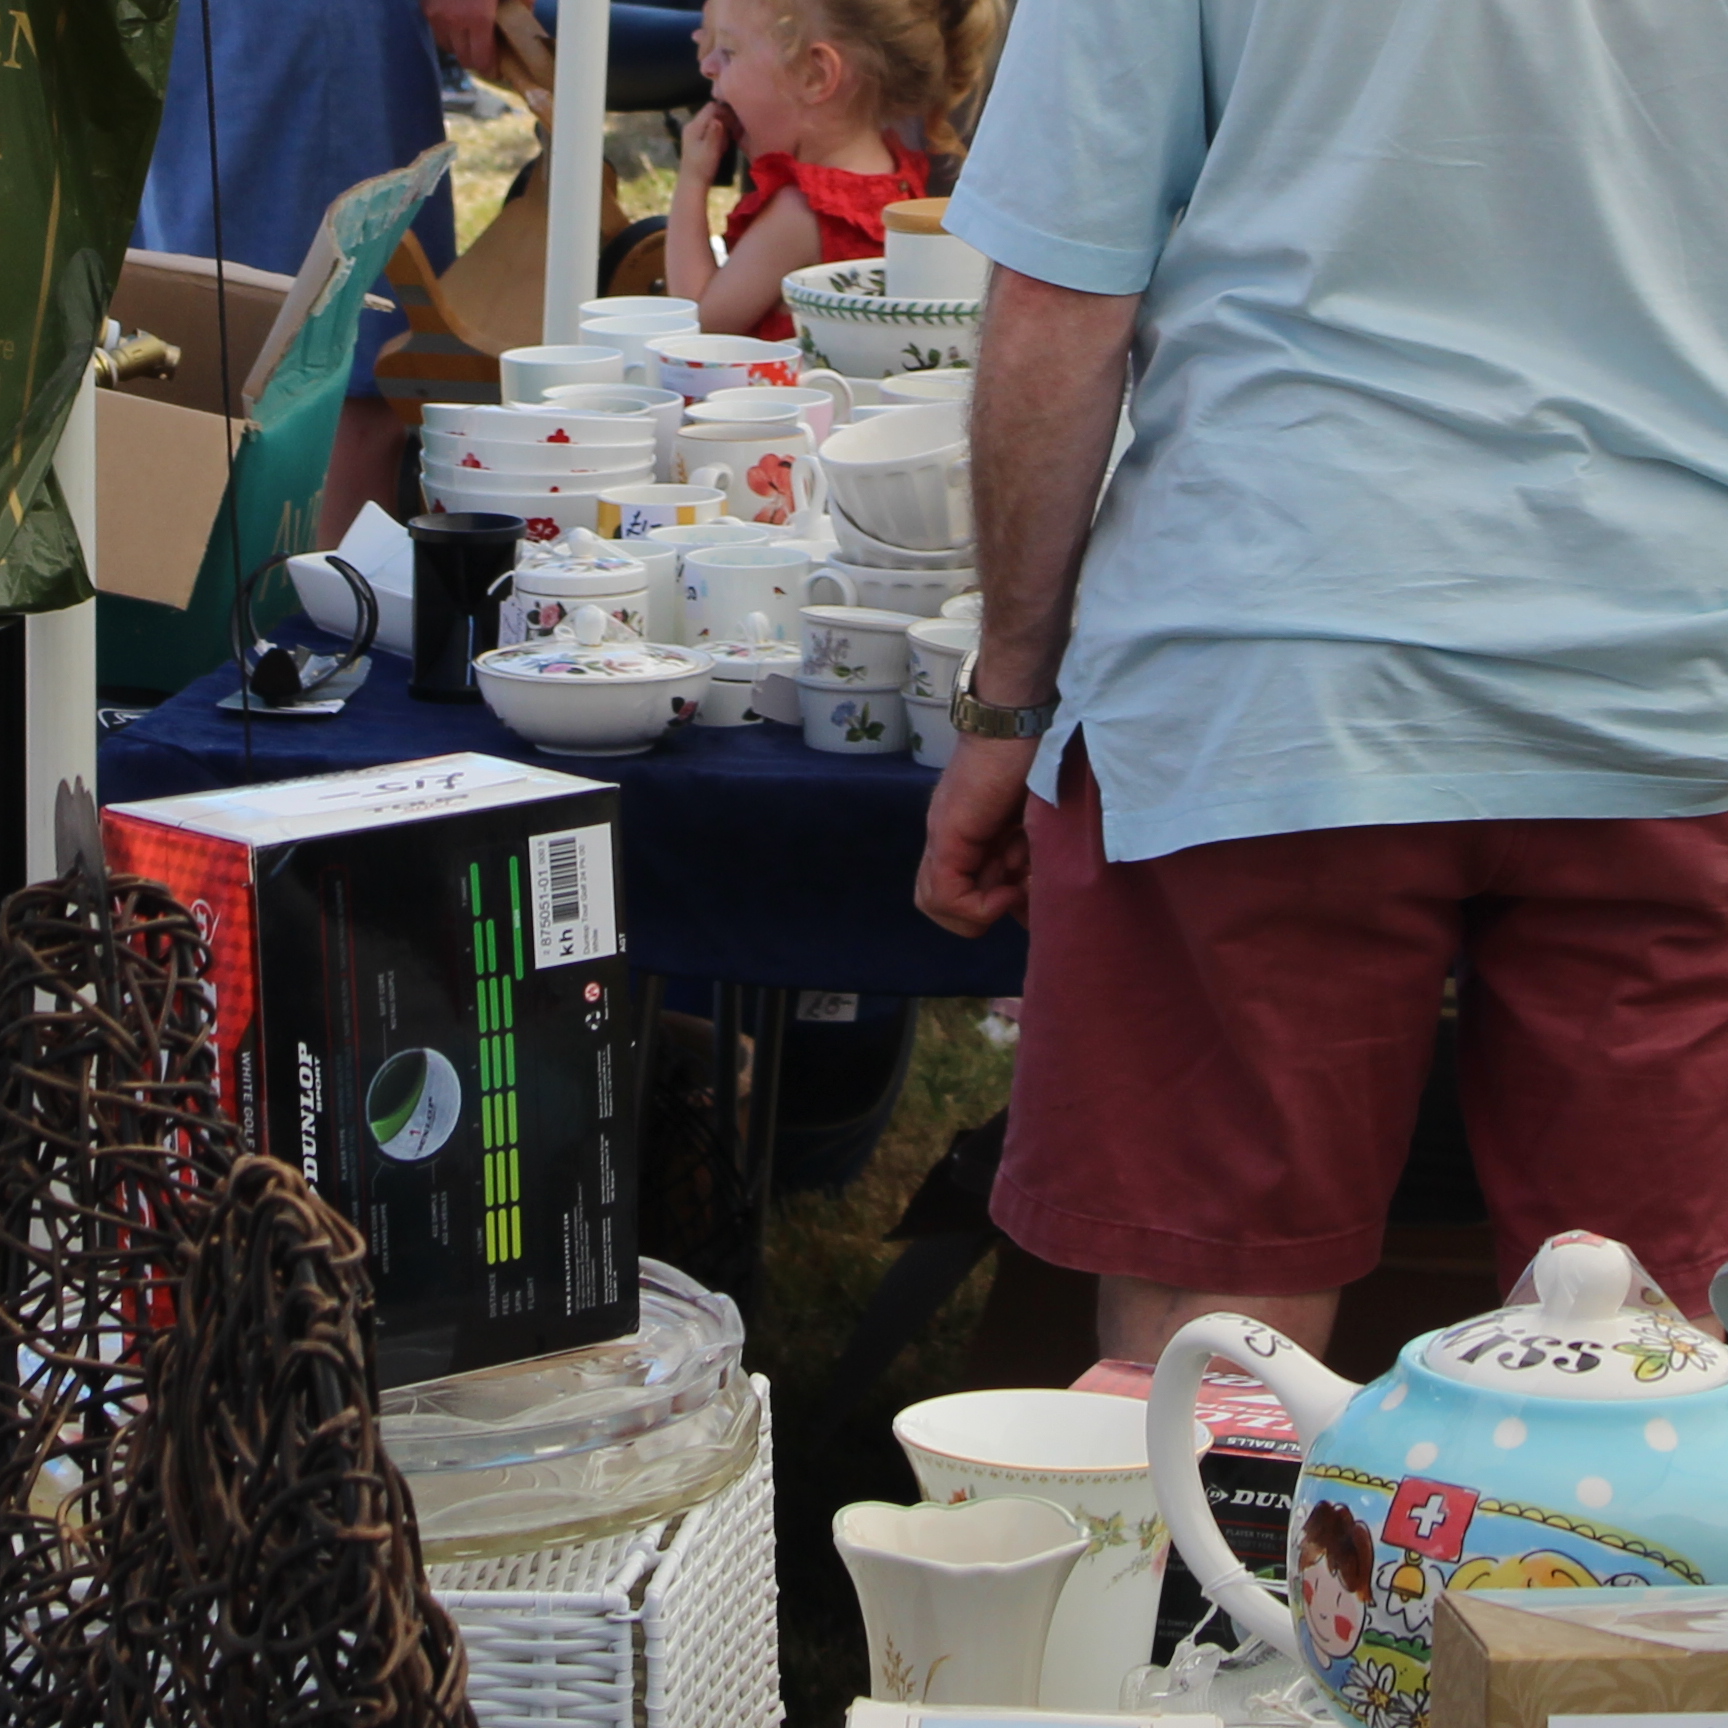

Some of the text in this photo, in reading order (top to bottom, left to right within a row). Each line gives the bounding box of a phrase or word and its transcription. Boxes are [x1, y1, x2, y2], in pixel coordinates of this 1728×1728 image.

[579, 883, 588, 902] Golf
[537, 869, 552, 947] 875051-01
[580, 903, 589, 923] Tour
[559, 928, 575, 957] kh
[582, 924, 591, 956] Dunlop
[590, 928, 599, 954] White
[239, 1051, 254, 1103] WHITE
[313, 1055, 324, 1114] SPORT
[296, 1041, 319, 1183] DUNLOP
[488, 1272, 498, 1318] DISTANCE
[501, 1291, 510, 1316] FEEL
[514, 1289, 523, 1313] SPIN
[526, 1276, 535, 1311] FLIGHT
[1227, 1436, 1275, 1450] BALLS
[1230, 1489, 1292, 1511] DUN
